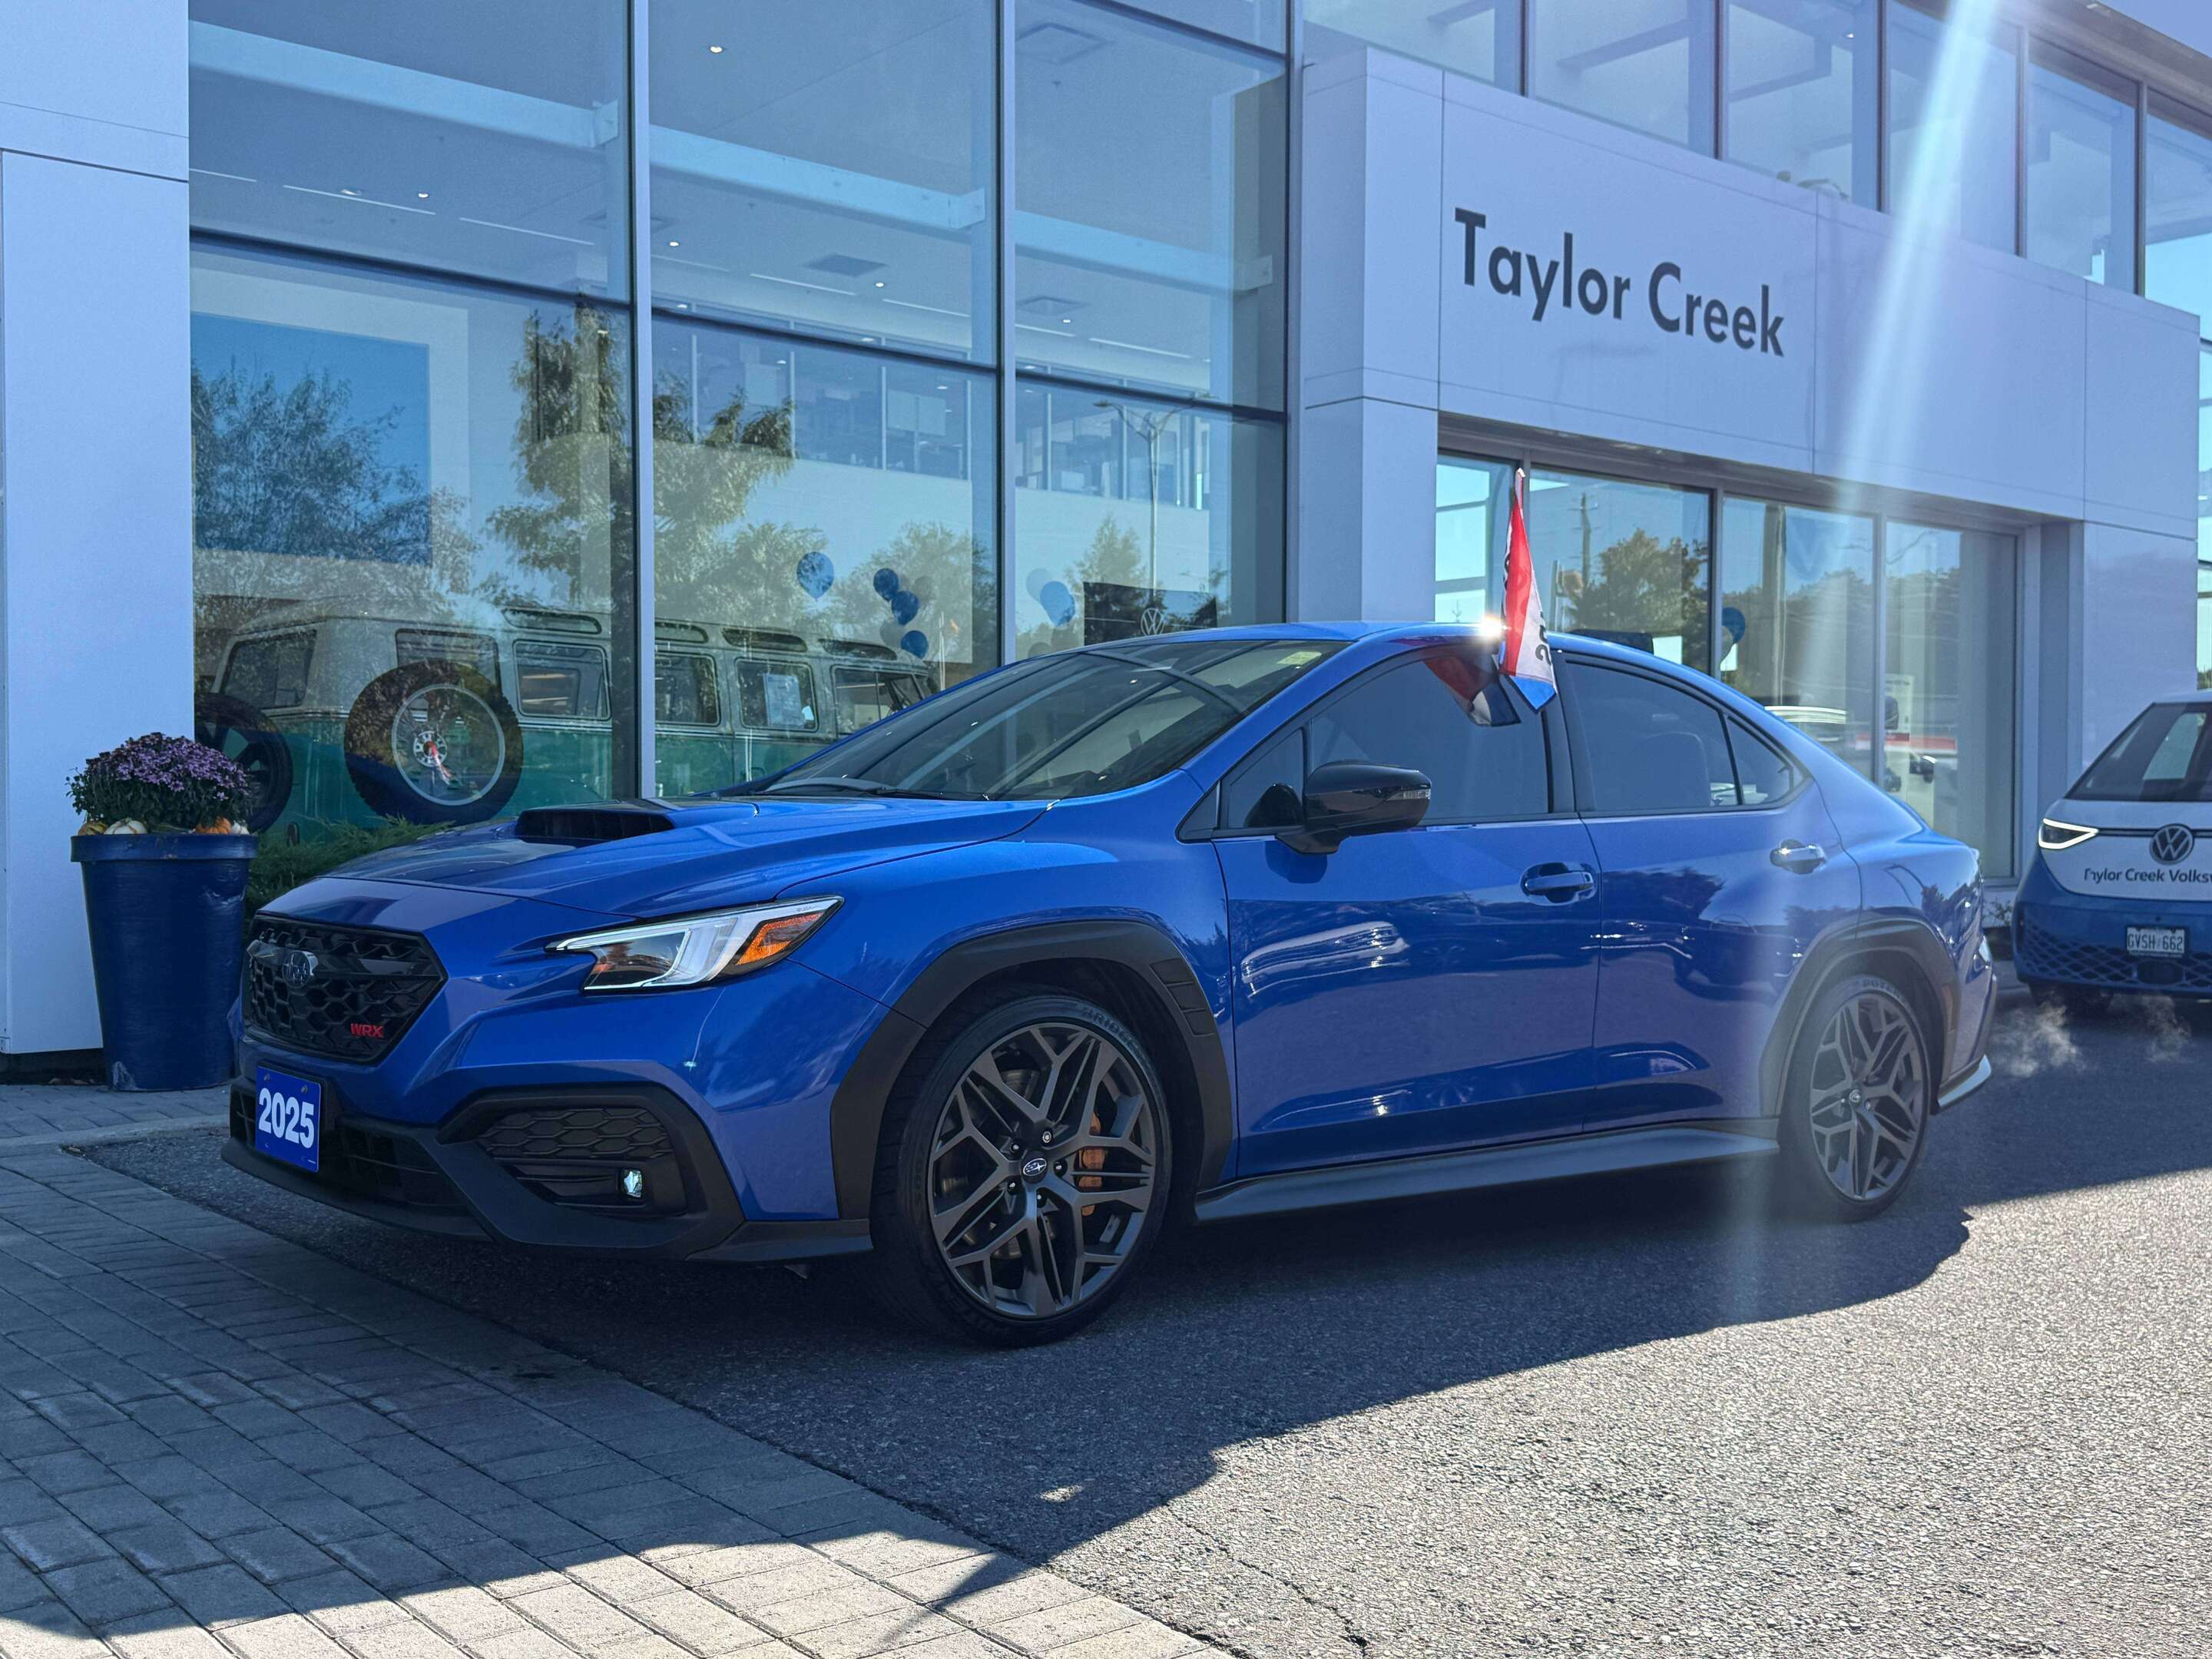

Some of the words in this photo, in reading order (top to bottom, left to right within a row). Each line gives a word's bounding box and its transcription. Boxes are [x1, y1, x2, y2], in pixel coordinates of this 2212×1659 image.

[1455, 207, 1631, 322] Taylor
[1648, 261, 1784, 357] Creek
[2124, 868, 2165, 882] Creek
[2168, 869, 2212, 883] Volks
[2162, 935, 2184, 951] 662
[350, 1022, 383, 1038] WRX
[258, 1087, 315, 1149] 2025
